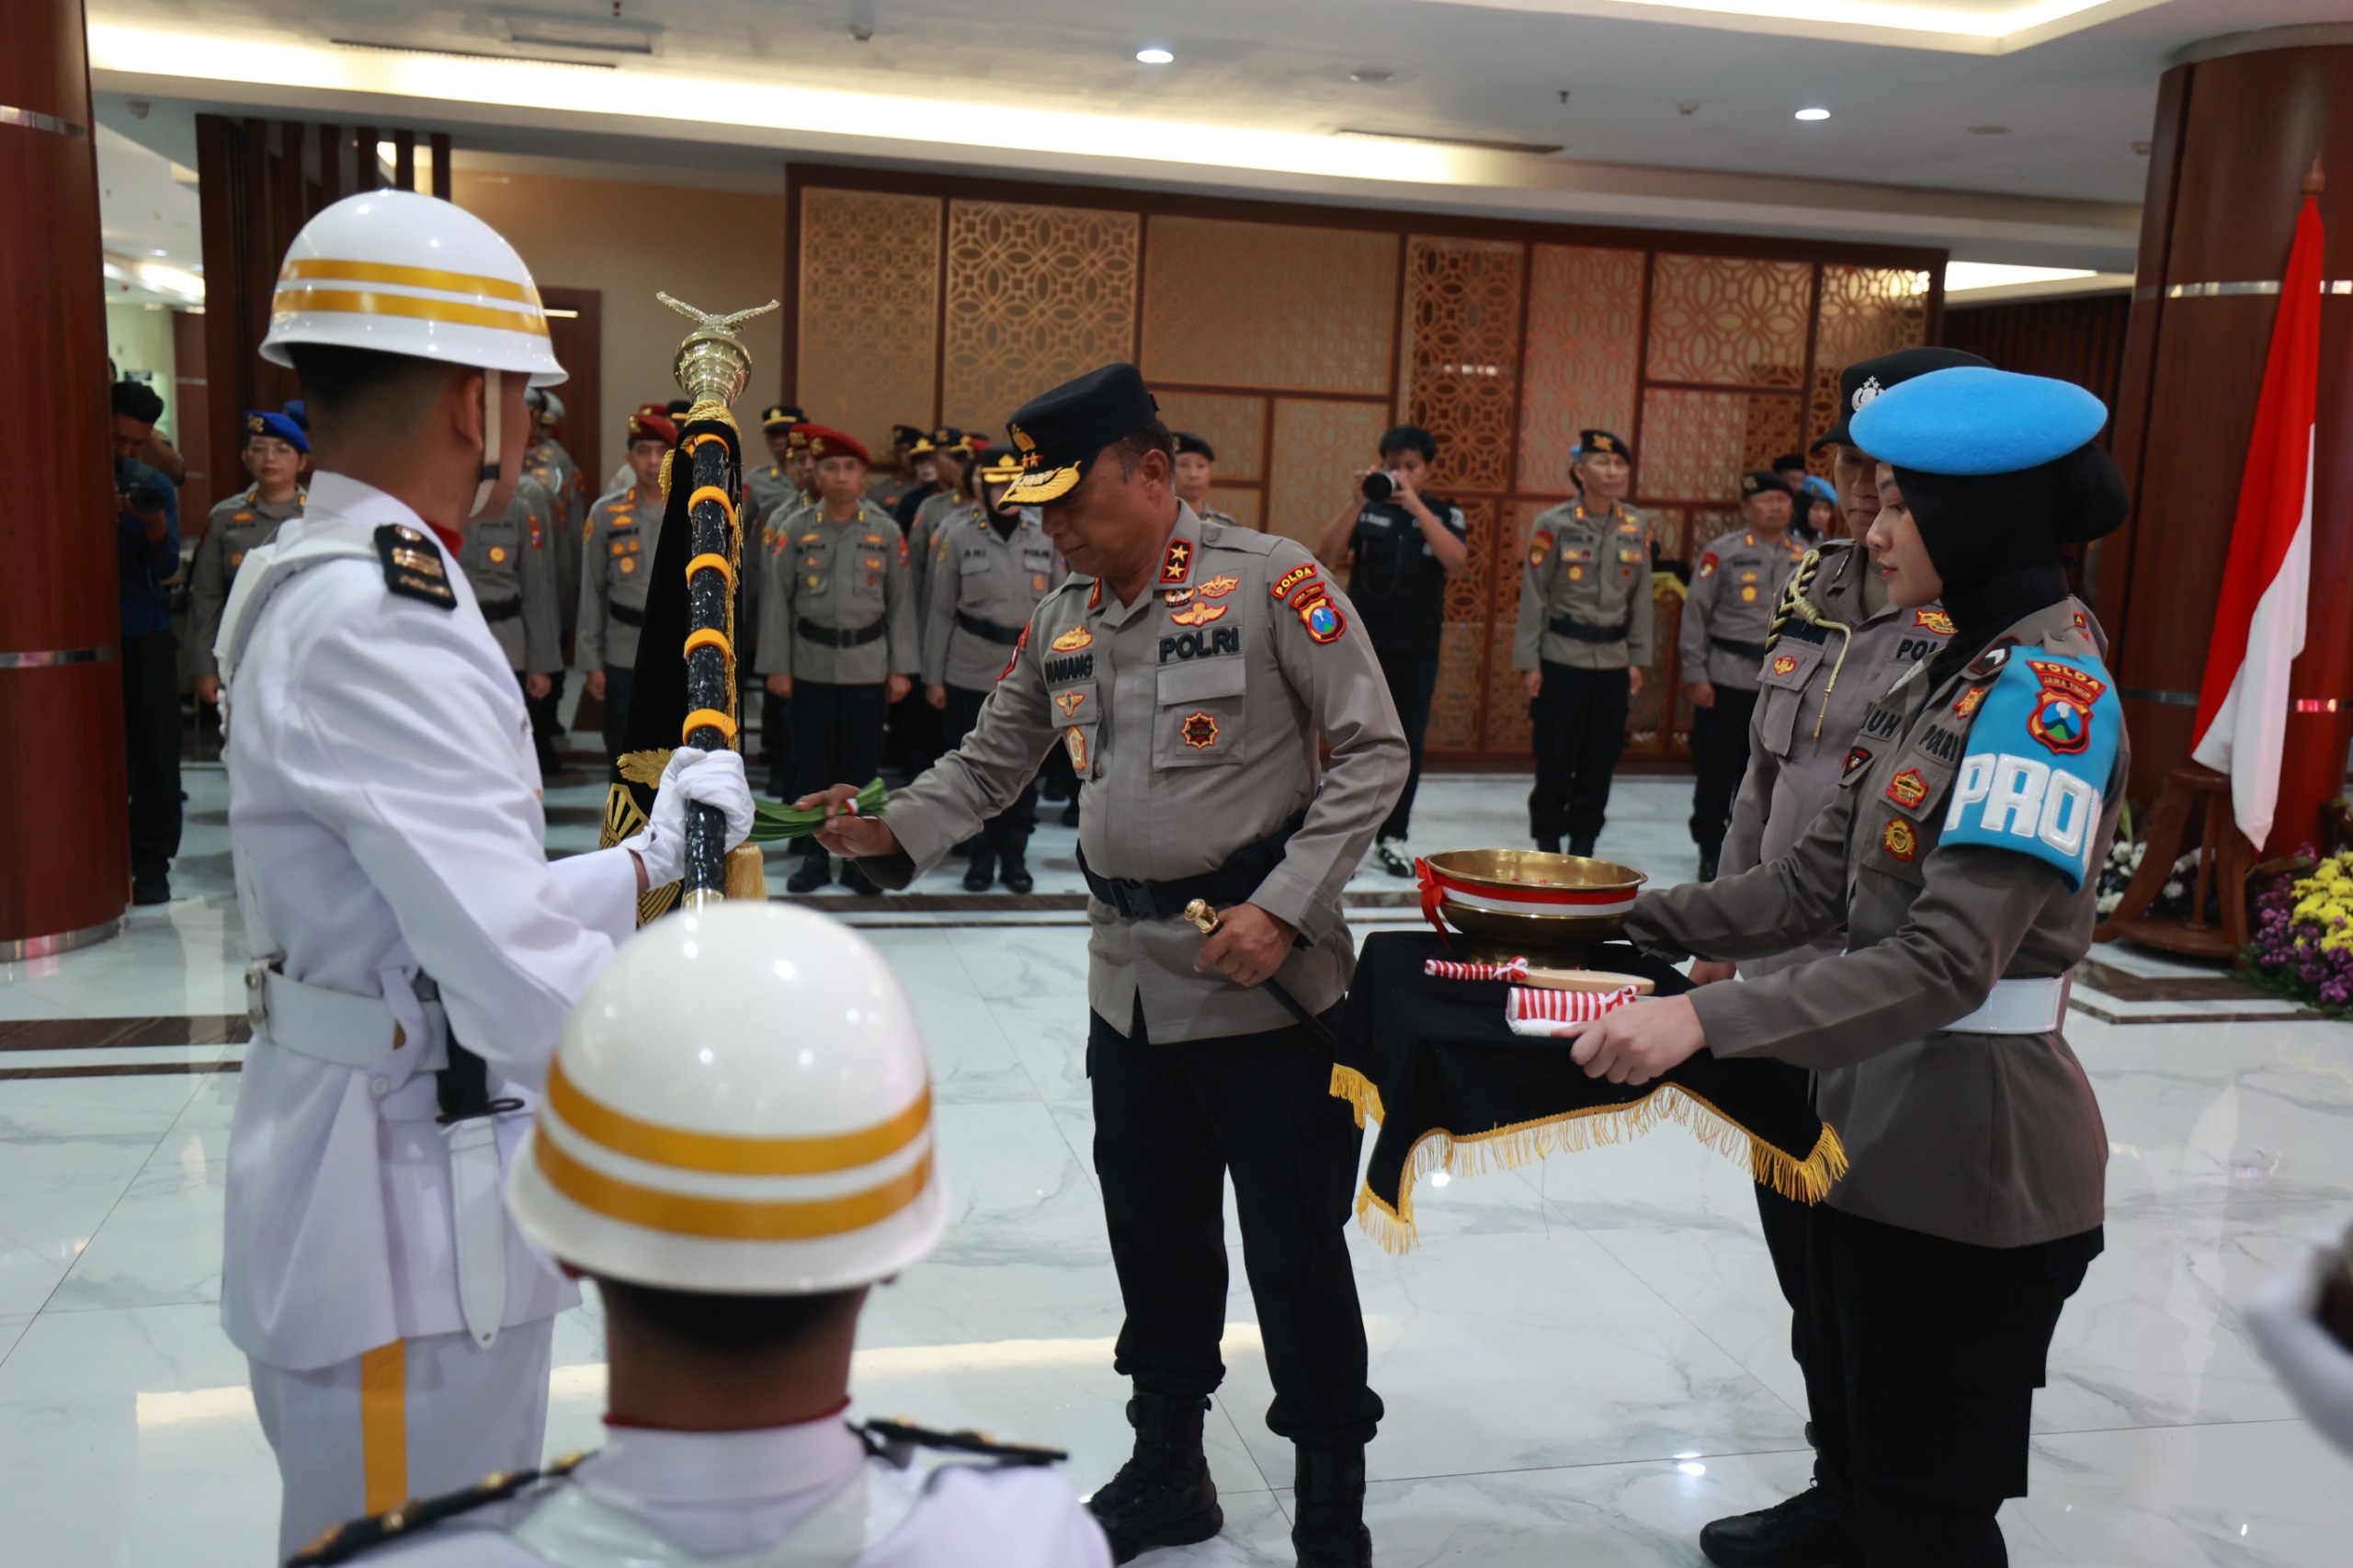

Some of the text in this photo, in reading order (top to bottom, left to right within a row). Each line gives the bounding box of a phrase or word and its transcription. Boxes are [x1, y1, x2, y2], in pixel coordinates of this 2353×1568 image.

[1275, 566, 1313, 596] POLDA
[1159, 626, 1240, 664] POLRI
[2032, 662, 2099, 690] POLDA
[2043, 676, 2093, 699] JAWA TIMUR
[1861, 706, 1903, 738] UH
[1943, 753, 2103, 870] PRO
